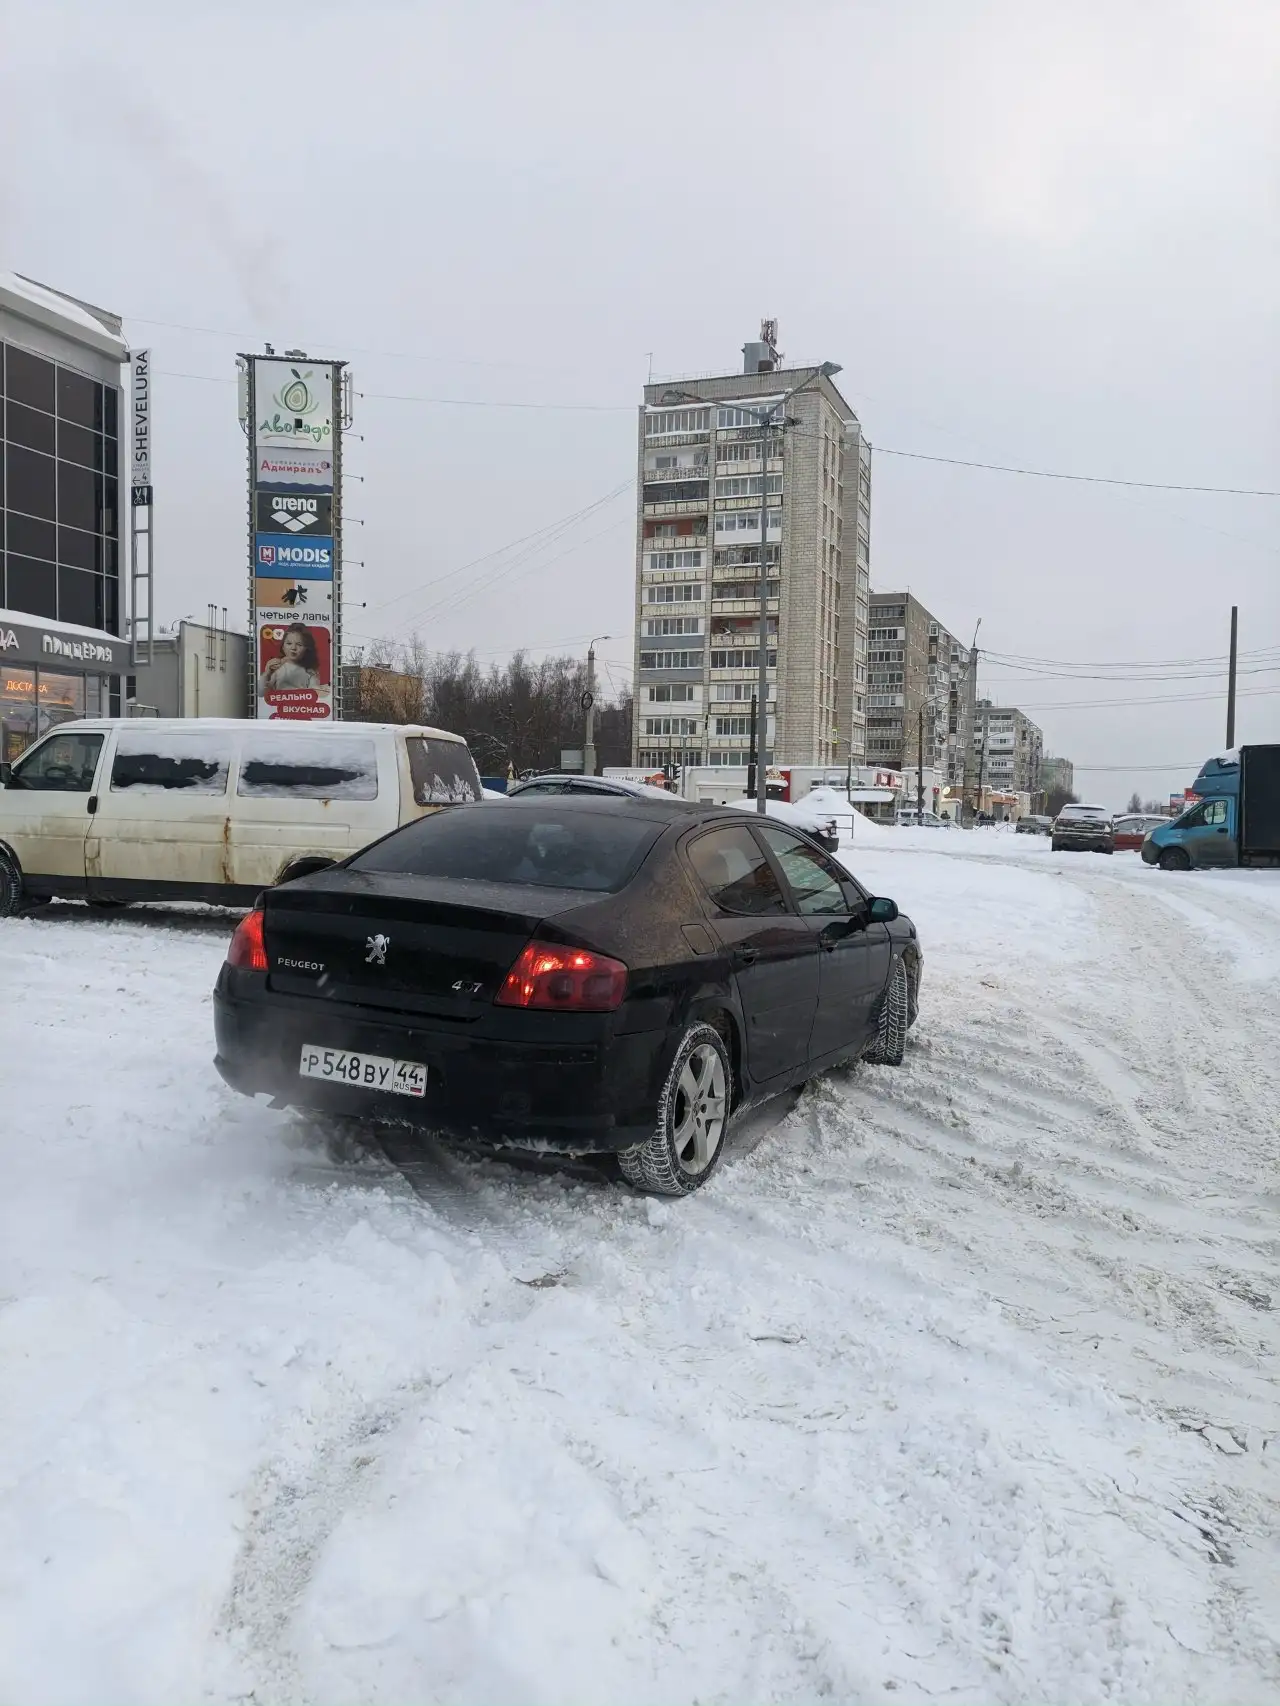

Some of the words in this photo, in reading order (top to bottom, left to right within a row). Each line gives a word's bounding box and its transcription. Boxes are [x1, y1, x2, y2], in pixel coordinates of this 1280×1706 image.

[135, 350, 148, 462] SHEVELURA
[272, 496, 317, 512] arena
[278, 546, 330, 563] MODIS
[301, 612, 330, 622] лапы
[42, 634, 113, 662] ПИЦЦЕРИЯ
[270, 693, 312, 702] РЕАЛЬНО
[283, 706, 325, 714] ВКУСНАЯ
[277, 957, 325, 972] PEUGEOT
[397, 1063, 419, 1085] 44
[393, 1081, 410, 1091] RUS
